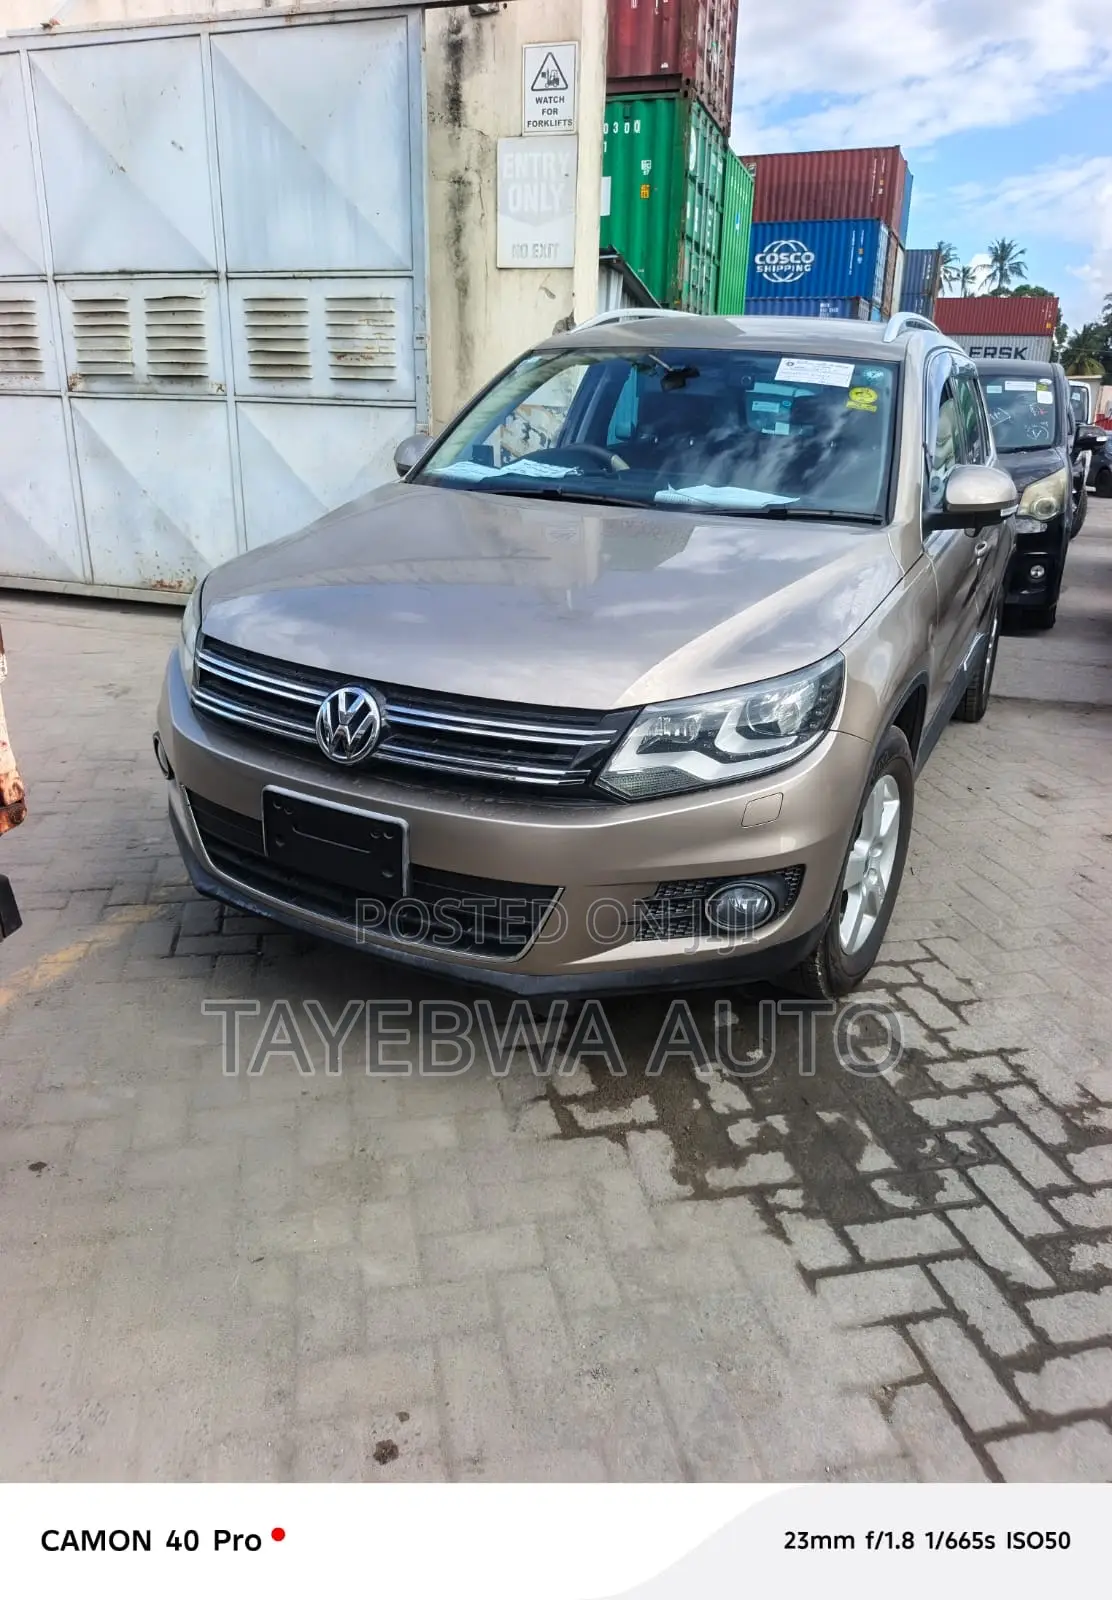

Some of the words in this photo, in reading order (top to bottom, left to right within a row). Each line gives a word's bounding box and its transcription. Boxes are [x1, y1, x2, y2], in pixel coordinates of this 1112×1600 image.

[535, 96, 565, 104] WATCH
[541, 108, 558, 116] FOR
[527, 119, 573, 128] FORKLIFTS
[503, 151, 570, 179] ENTRY
[508, 182, 565, 213] ONLY
[512, 243, 528, 259] NO
[532, 243, 560, 259] EXIT
[754, 251, 815, 265] COSCO
[756, 264, 812, 273] SHIPPING
[968, 346, 1028, 360] ERSK
